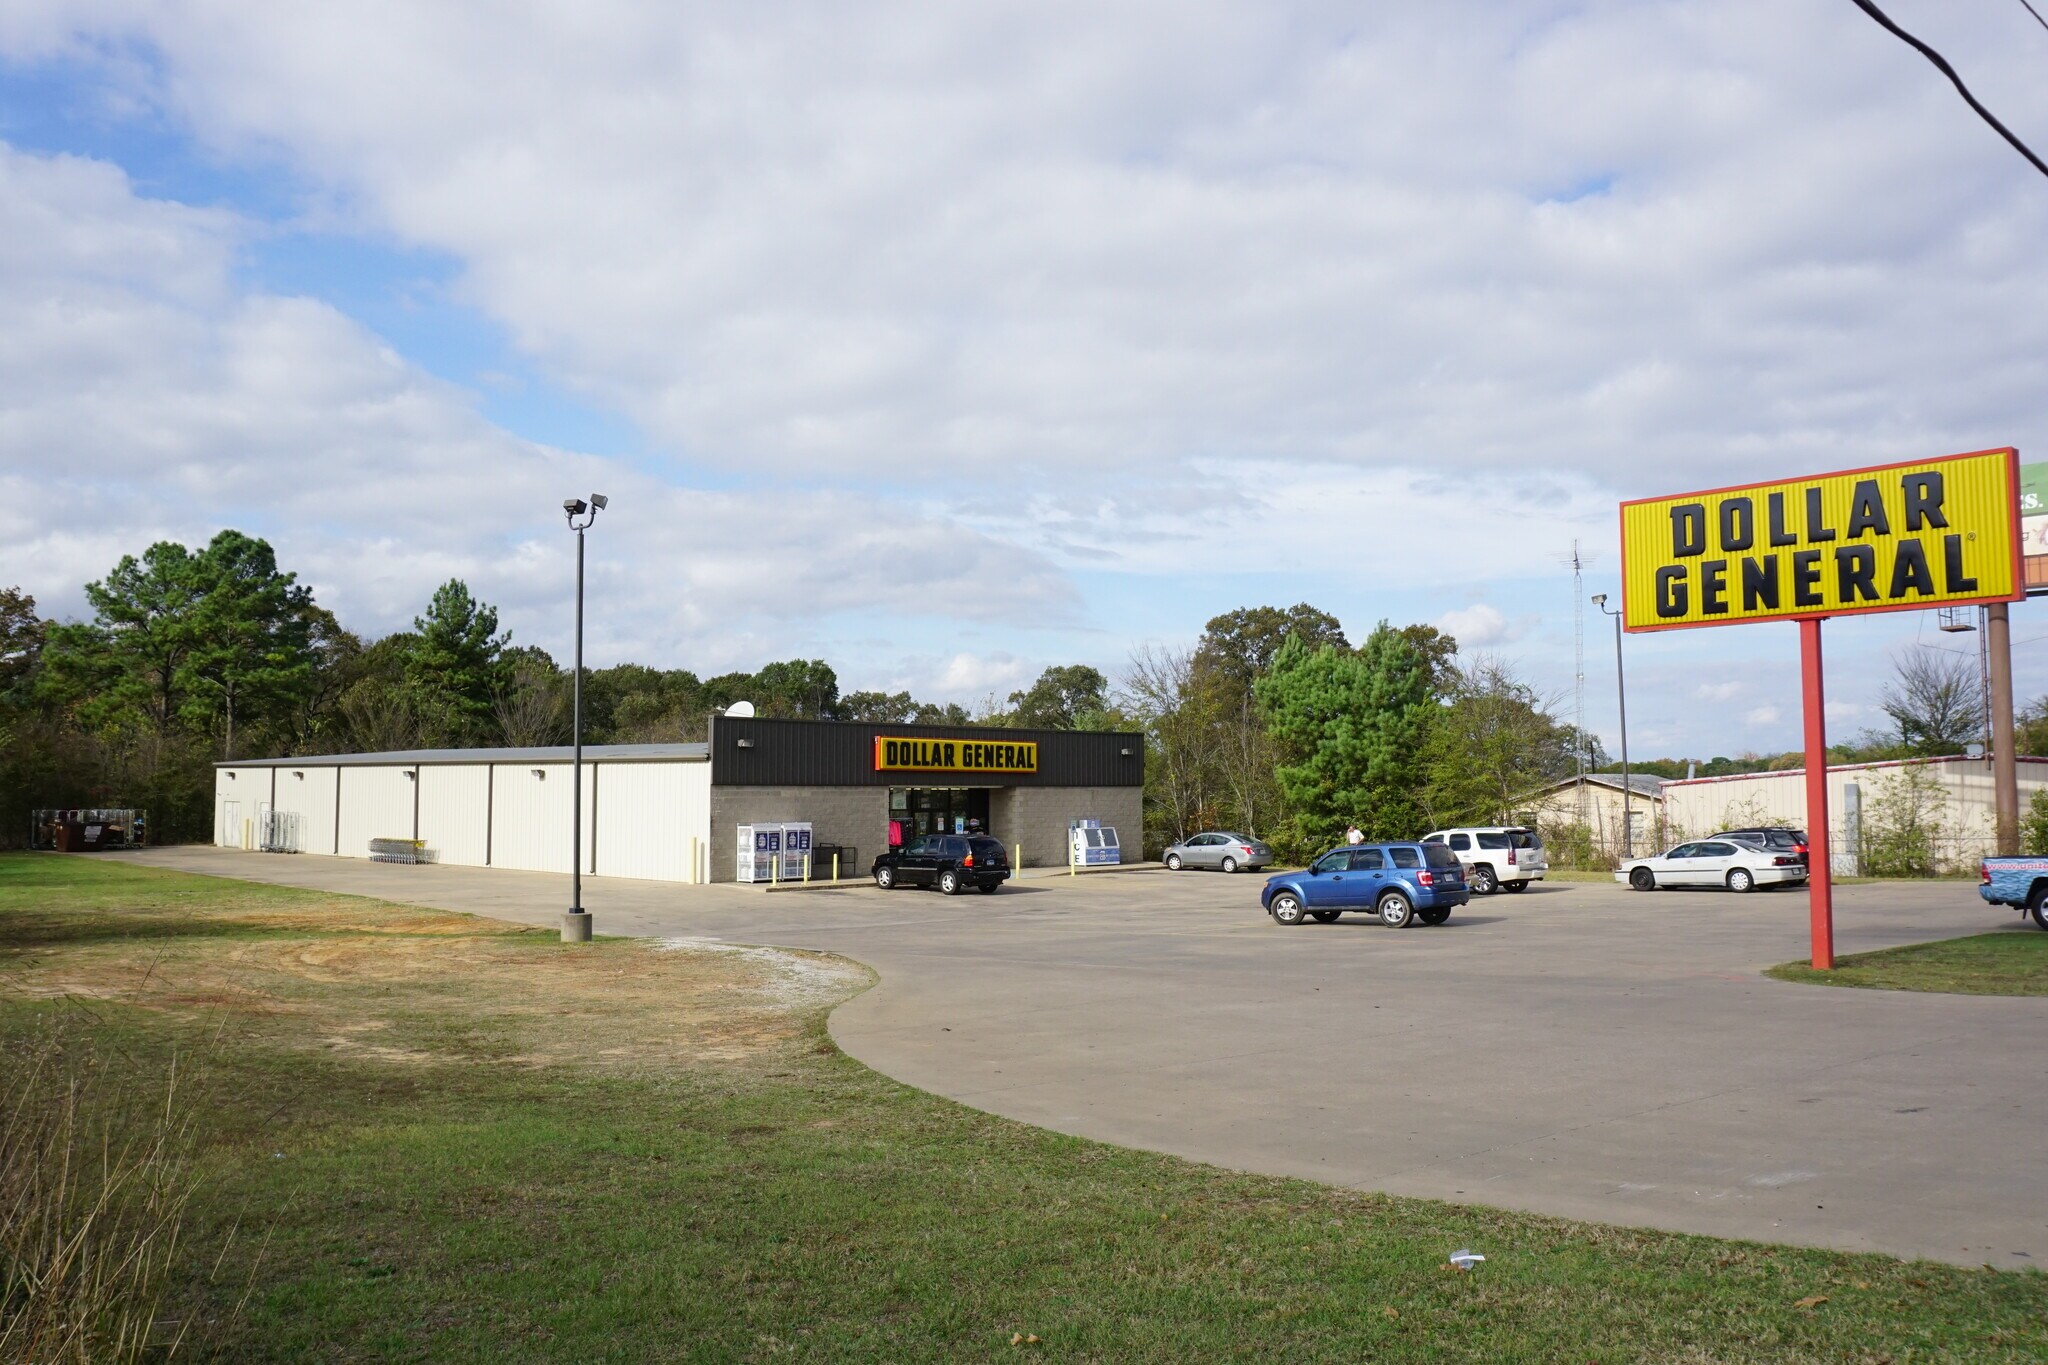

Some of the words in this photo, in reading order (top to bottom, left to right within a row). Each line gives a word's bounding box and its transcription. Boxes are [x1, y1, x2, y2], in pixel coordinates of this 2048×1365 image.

[1669, 471, 1950, 559] DOLLAR
[1655, 533, 1978, 619] GENERAL
[886, 741, 955, 766] DOLLAR
[963, 744, 1034, 769] GENERAL
